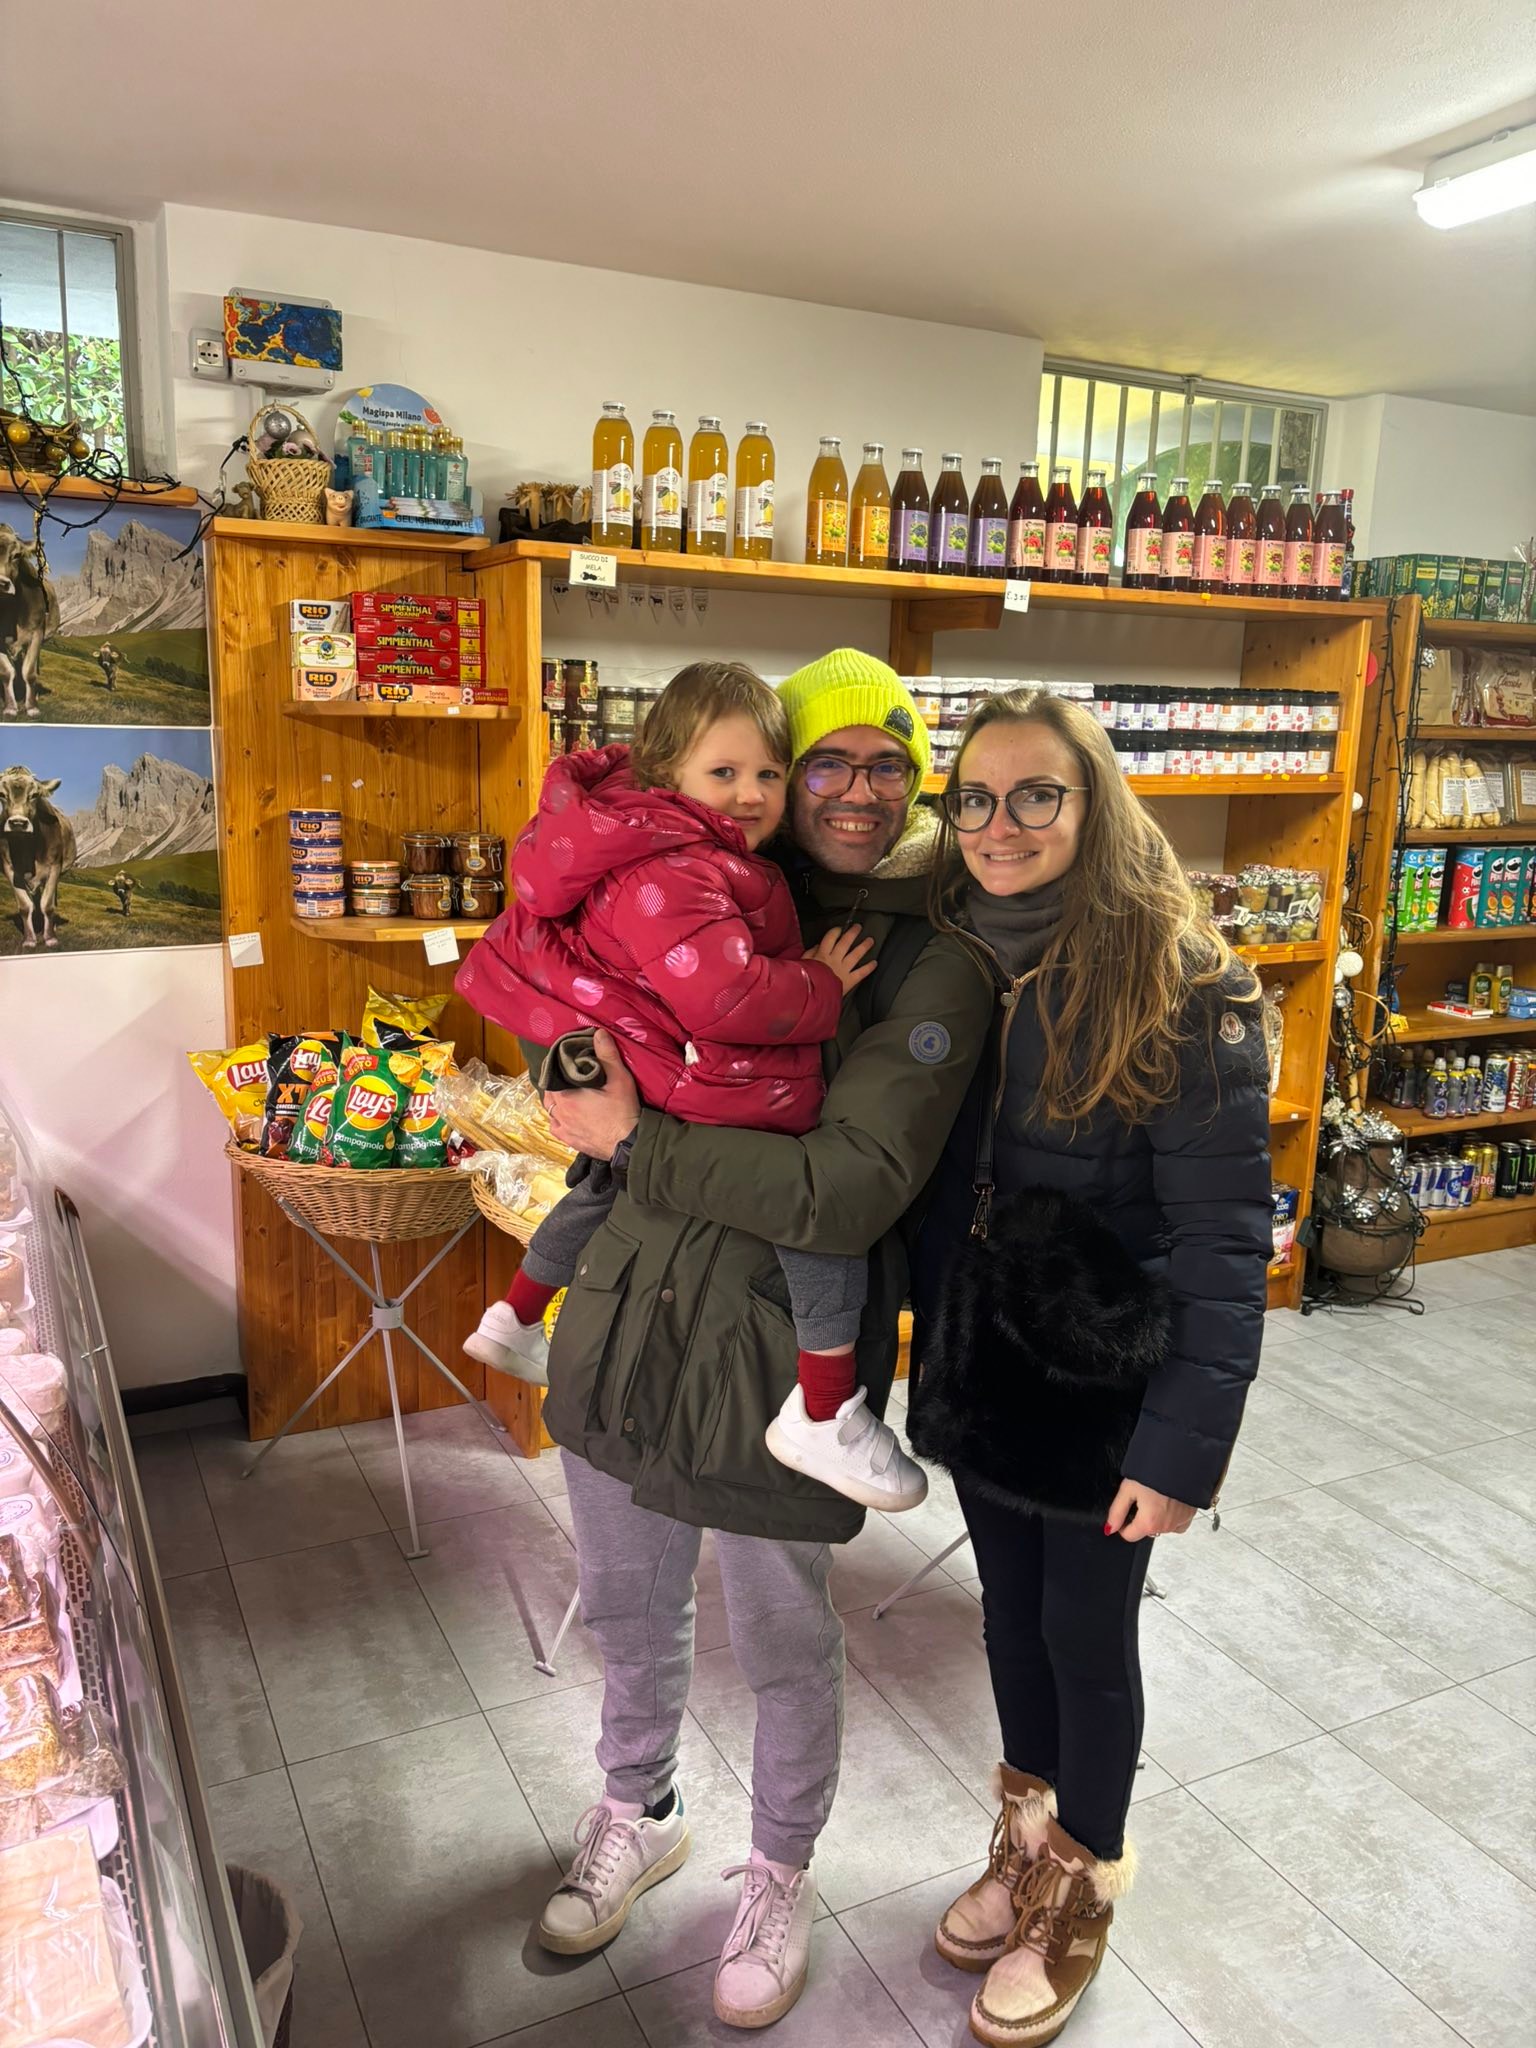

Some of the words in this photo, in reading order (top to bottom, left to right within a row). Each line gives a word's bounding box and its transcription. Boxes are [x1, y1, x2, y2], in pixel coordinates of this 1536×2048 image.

[362, 406, 394, 418] Magispa
[396, 410, 422, 421] Milano
[302, 606, 328, 615] RIO
[381, 603, 432, 615] SIMMENTHAL
[377, 636, 434, 648] SIMMENTHAL
[376, 664, 435, 675] SIMMENTHAL
[308, 673, 335, 683] RIO
[380, 686, 410, 696] RIO
[462, 687, 474, 705] 8
[293, 1048, 320, 1073] Lay
[231, 1060, 267, 1088] Lay
[313, 1073, 337, 1086] GUST
[1508, 1063, 1521, 1109] AriZona
[277, 1084, 309, 1104] XT
[347, 1085, 395, 1118] Lay's
